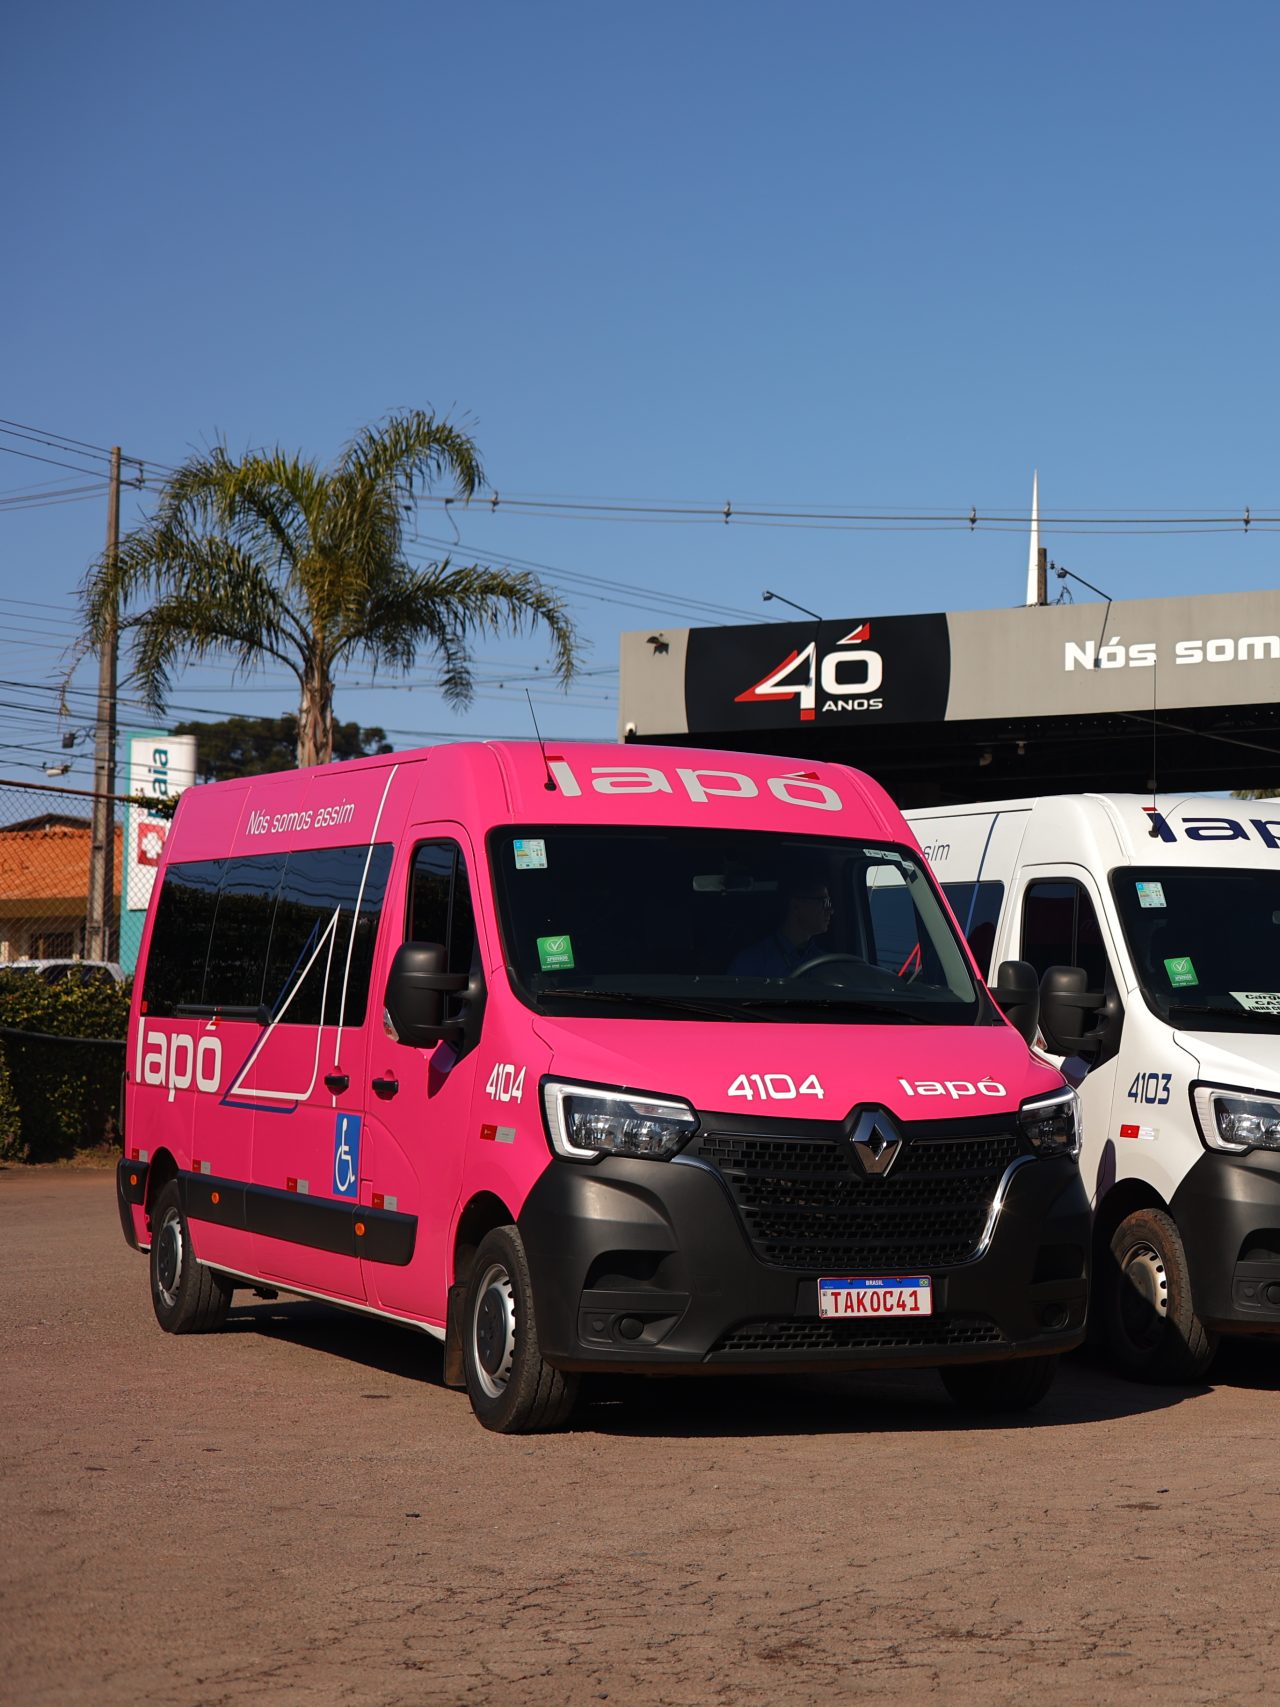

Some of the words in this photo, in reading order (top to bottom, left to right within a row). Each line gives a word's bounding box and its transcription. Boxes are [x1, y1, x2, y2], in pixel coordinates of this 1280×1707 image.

[1065, 636, 1158, 671] Nós
[821, 698, 884, 712] ANOS
[148, 748, 169, 819] aia
[246, 809, 270, 835] Nós
[271, 810, 313, 833] somos
[314, 798, 355, 828] assim
[923, 839, 951, 861] sim
[486, 1063, 526, 1104] 4104
[727, 1074, 825, 1100] 4104
[1128, 1072, 1172, 1104] 4103
